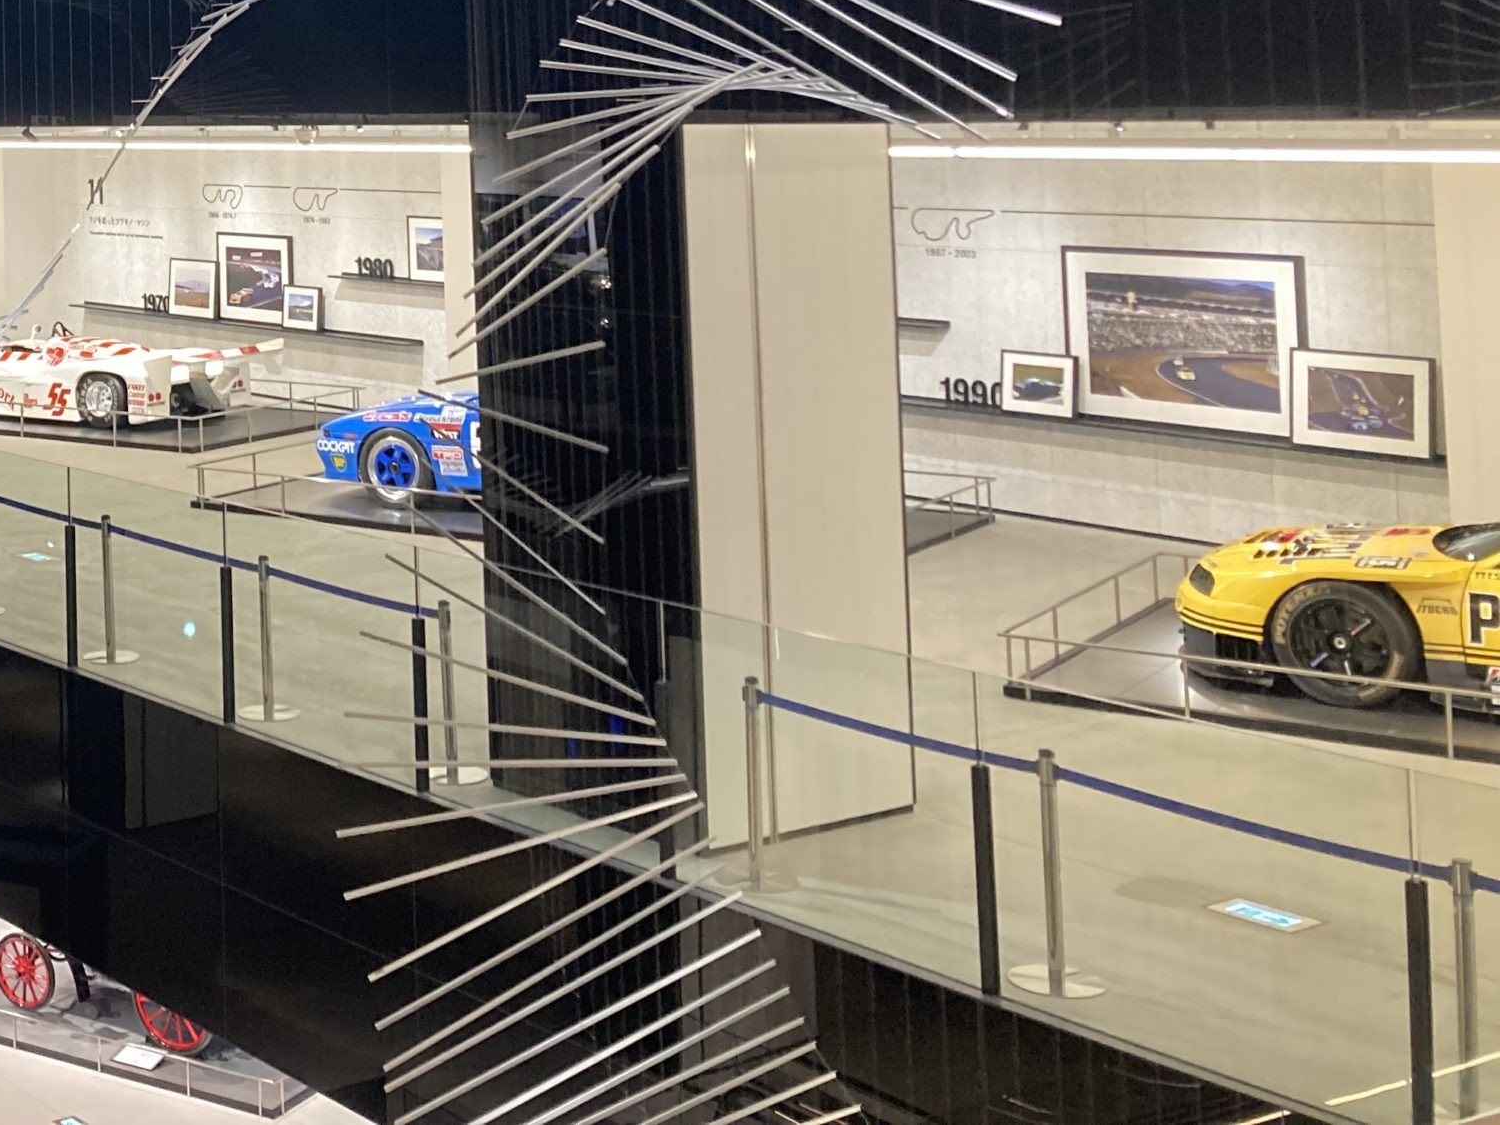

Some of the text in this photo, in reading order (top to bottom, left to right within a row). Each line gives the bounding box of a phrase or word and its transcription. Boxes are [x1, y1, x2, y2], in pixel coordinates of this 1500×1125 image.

[355, 257, 394, 280] 1980
[43, 383, 71, 416] 55
[317, 439, 356, 454] COCKPIT
[1468, 591, 1500, 645] P
